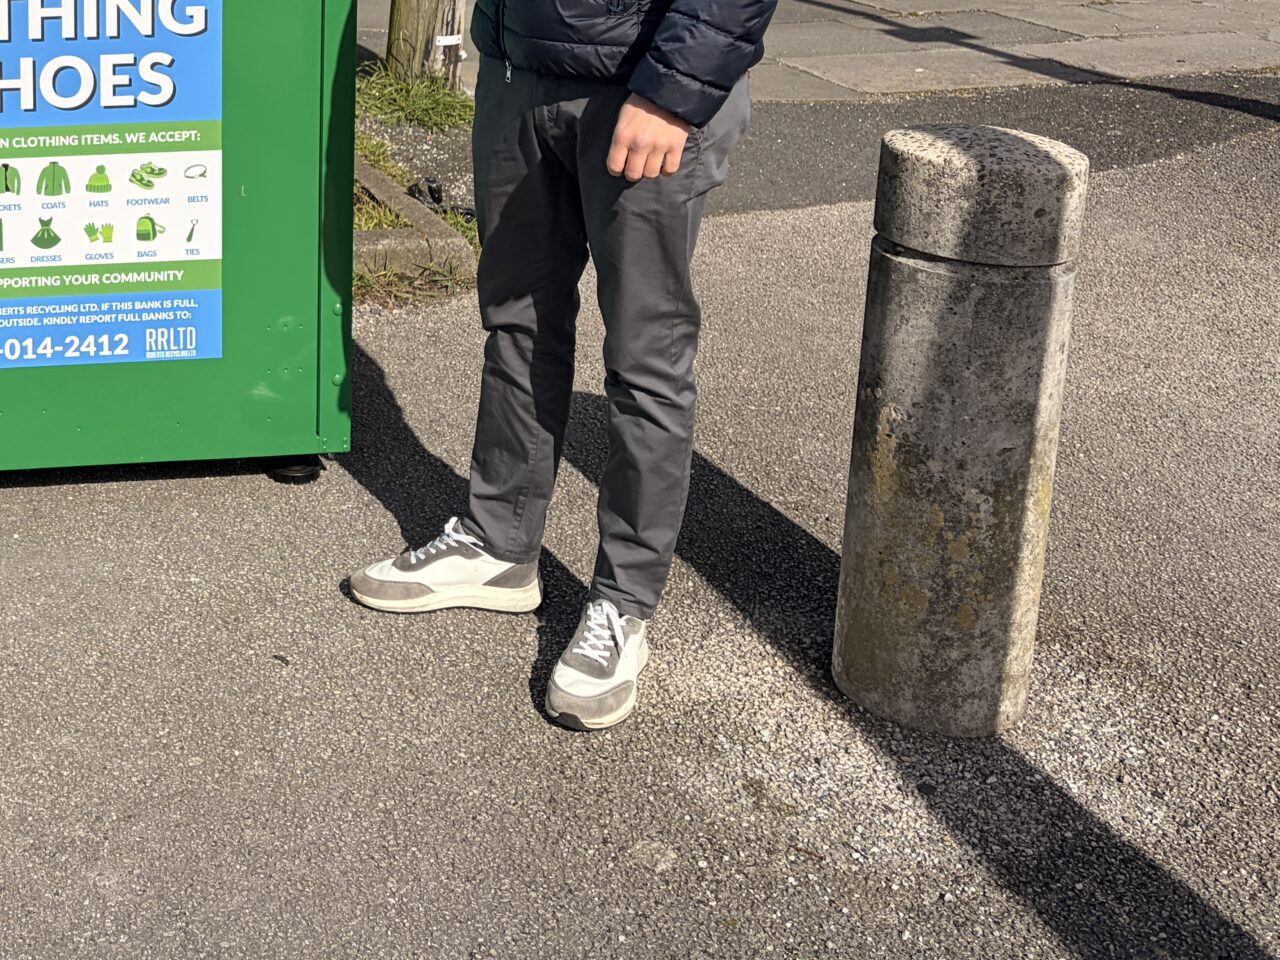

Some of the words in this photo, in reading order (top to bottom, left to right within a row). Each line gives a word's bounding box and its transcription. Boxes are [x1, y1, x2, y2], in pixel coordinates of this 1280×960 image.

[12, 135, 79, 148] CLOTHING
[81, 133, 123, 146] ITEMS.
[125, 132, 146, 144] WE
[148, 130, 201, 143] ACCEPT:
[89, 199, 109, 208] HATS
[126, 197, 170, 206] FOOTWEAR
[187, 195, 209, 203] BELTS
[41, 201, 66, 210] COATS
[85, 252, 114, 261] GLOVES
[137, 250, 158, 258] BAGS
[185, 248, 200, 256] TIES
[30, 254, 62, 263] DRESSES
[63, 273, 100, 287] YOUR
[102, 270, 184, 284] COMMUNITY
[26, 303, 78, 314] RECYCLING
[80, 303, 100, 312] LTD.
[101, 302, 111, 311] IF
[111, 301, 133, 310] THIS
[134, 300, 162, 309] BANK
[163, 300, 172, 308] IS
[43, 316, 79, 326] KINDLY
[80, 314, 116, 324] REPORT
[118, 313, 140, 322] FULL
[142, 311, 174, 321] BANKS
[176, 310, 192, 320] TO:
[145, 326, 196, 351] RRLTD
